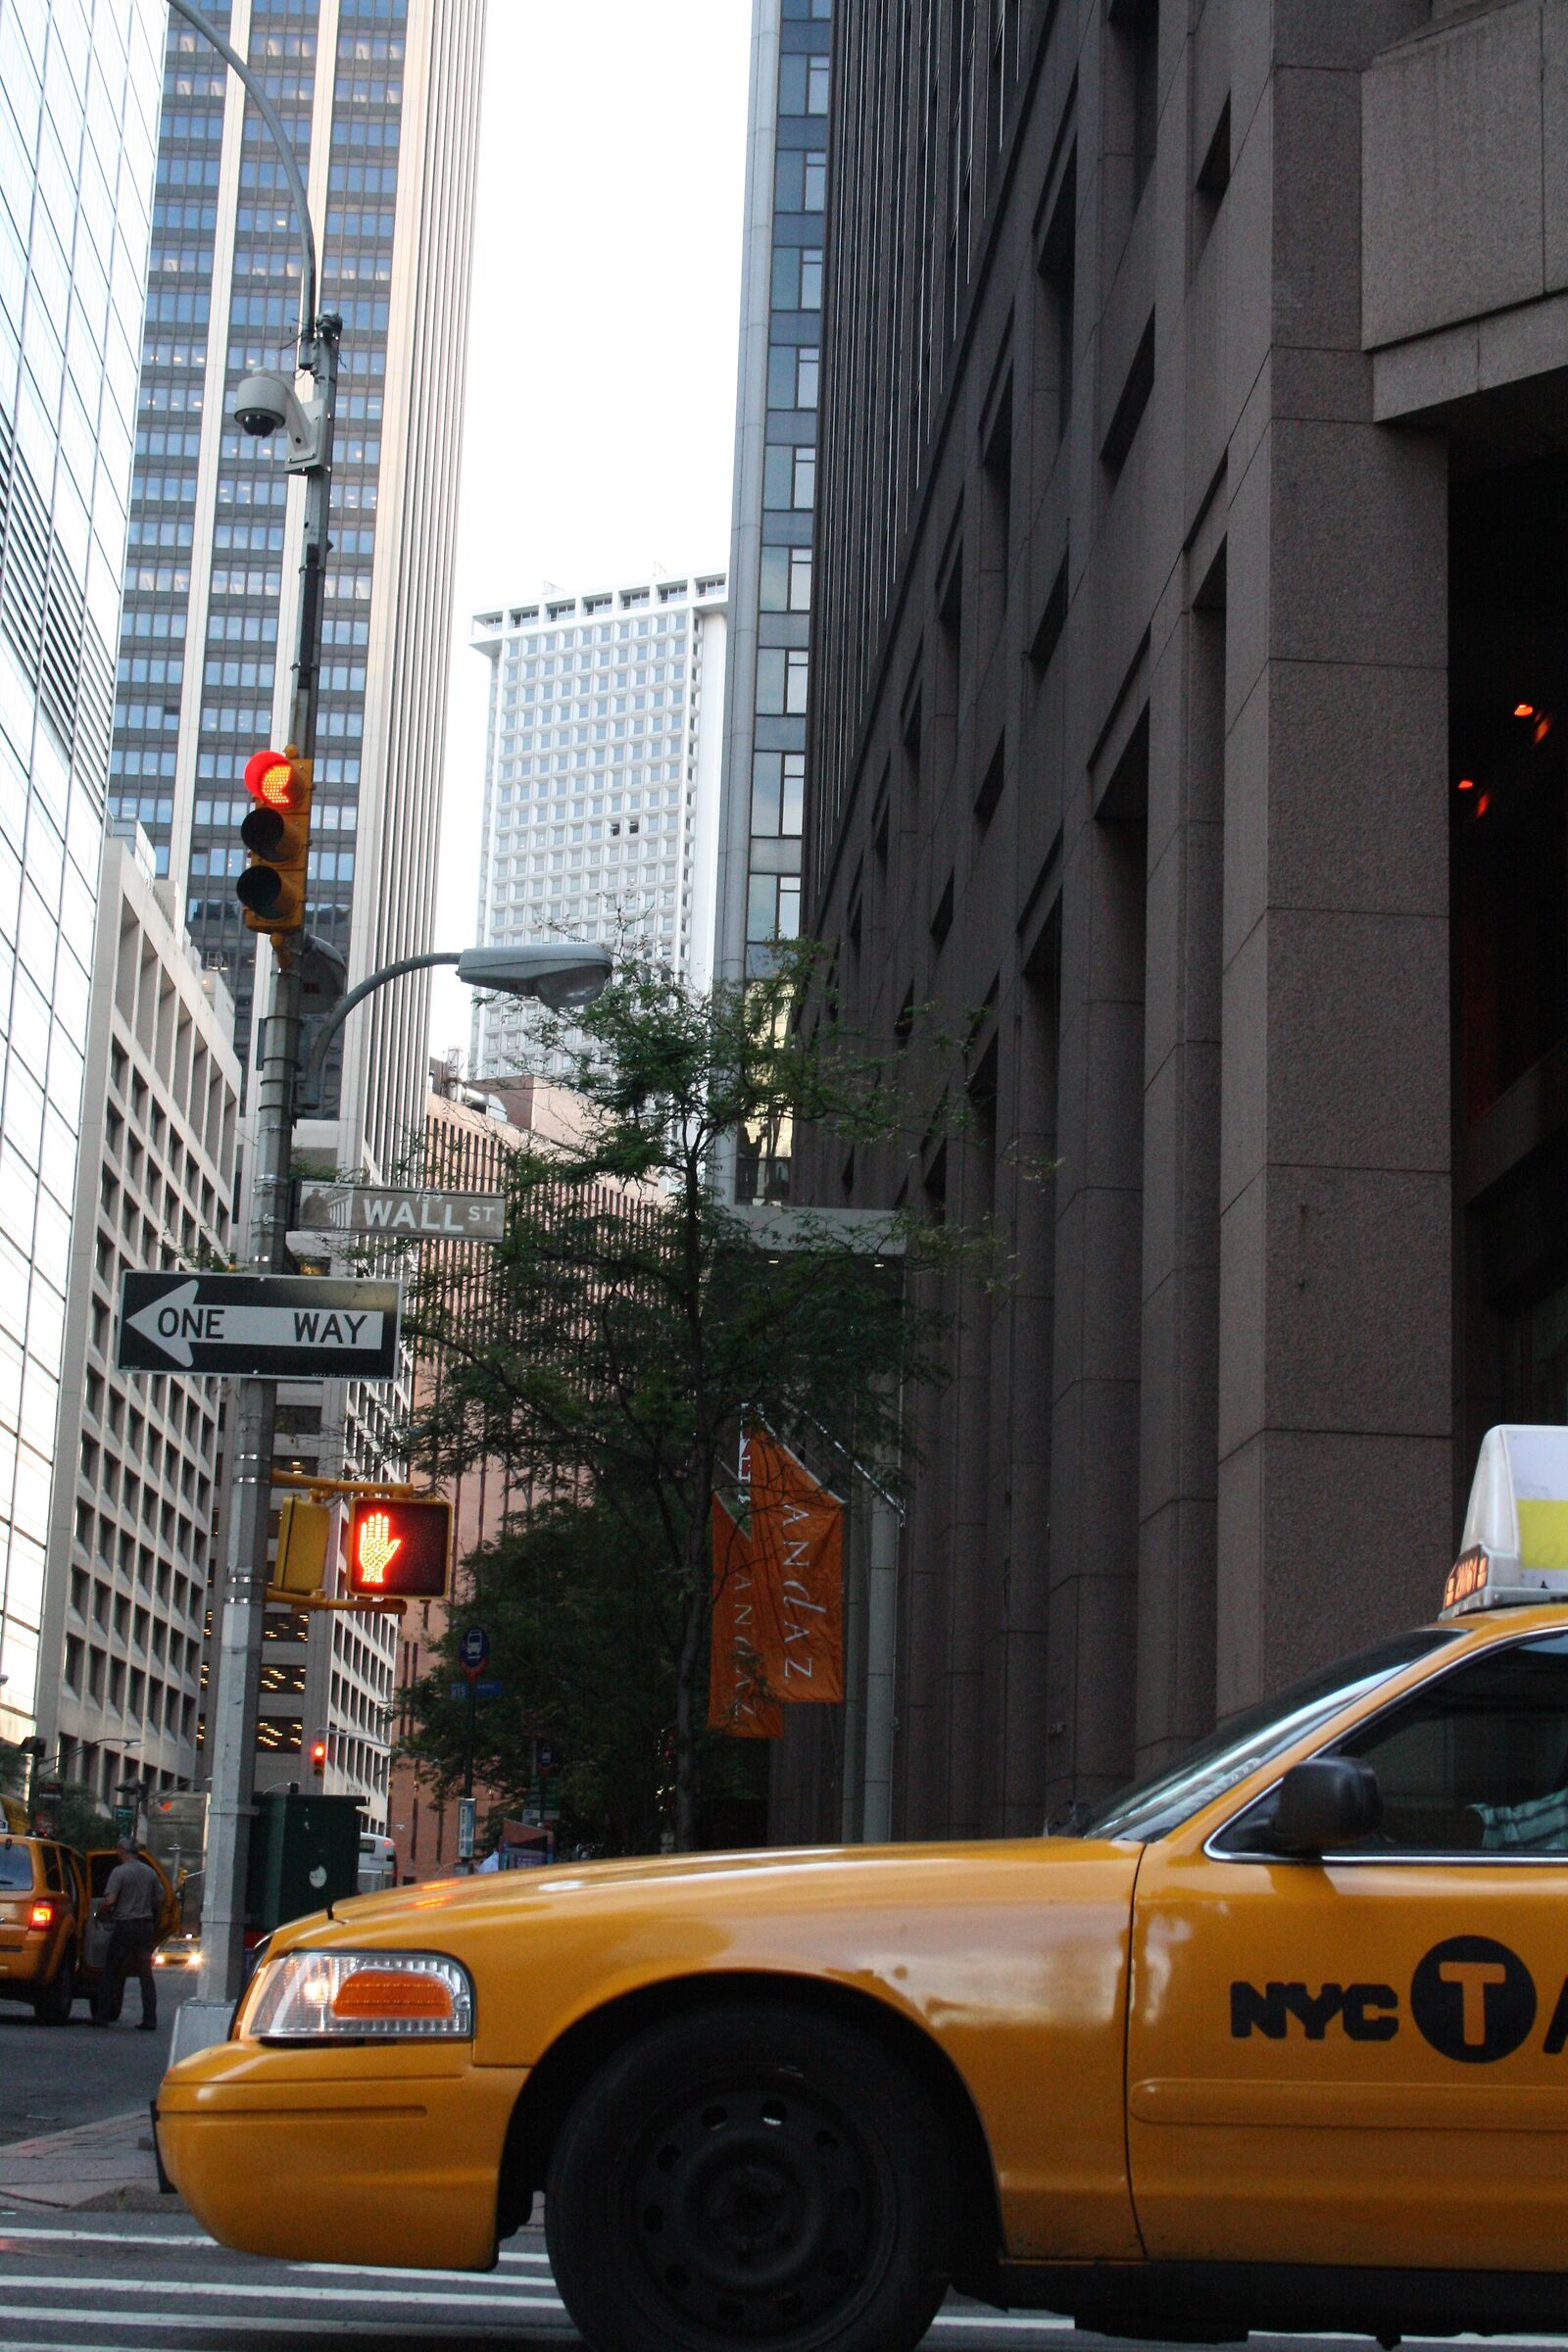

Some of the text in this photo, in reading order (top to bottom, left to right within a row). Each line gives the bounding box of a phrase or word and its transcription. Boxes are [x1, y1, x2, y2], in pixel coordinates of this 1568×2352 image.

[364, 1199, 495, 1232] WALL ST
[158, 1307, 368, 1344] ONE WAY
[1230, 1981, 1399, 2042] NYC
